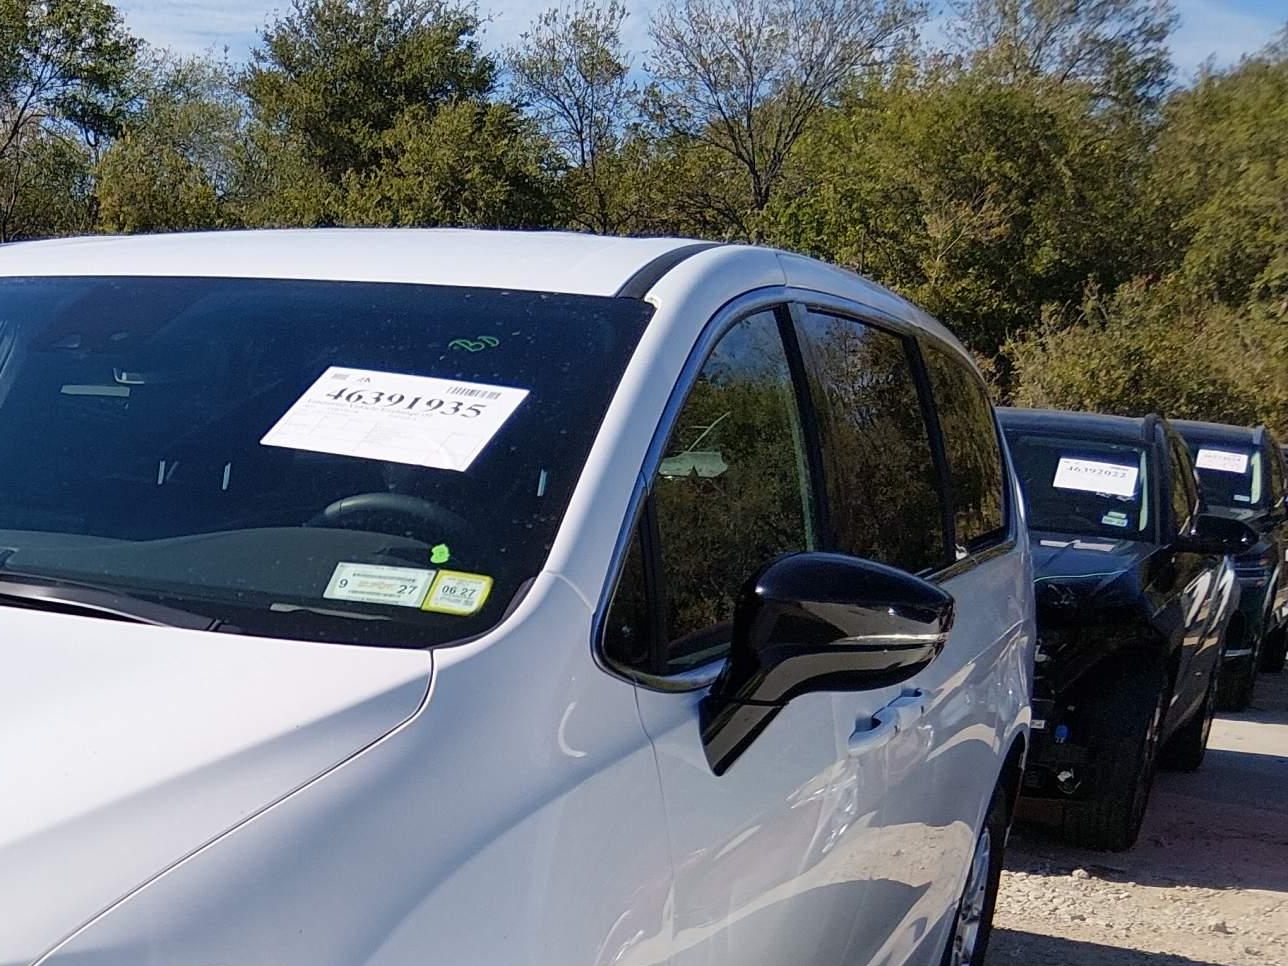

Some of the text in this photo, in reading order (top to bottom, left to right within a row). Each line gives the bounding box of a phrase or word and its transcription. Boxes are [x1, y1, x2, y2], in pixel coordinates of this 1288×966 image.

[326, 387, 487, 419] 46391935
[338, 577, 349, 590] 9
[396, 583, 419, 597] 27
[440, 584, 477, 599] 06 27
